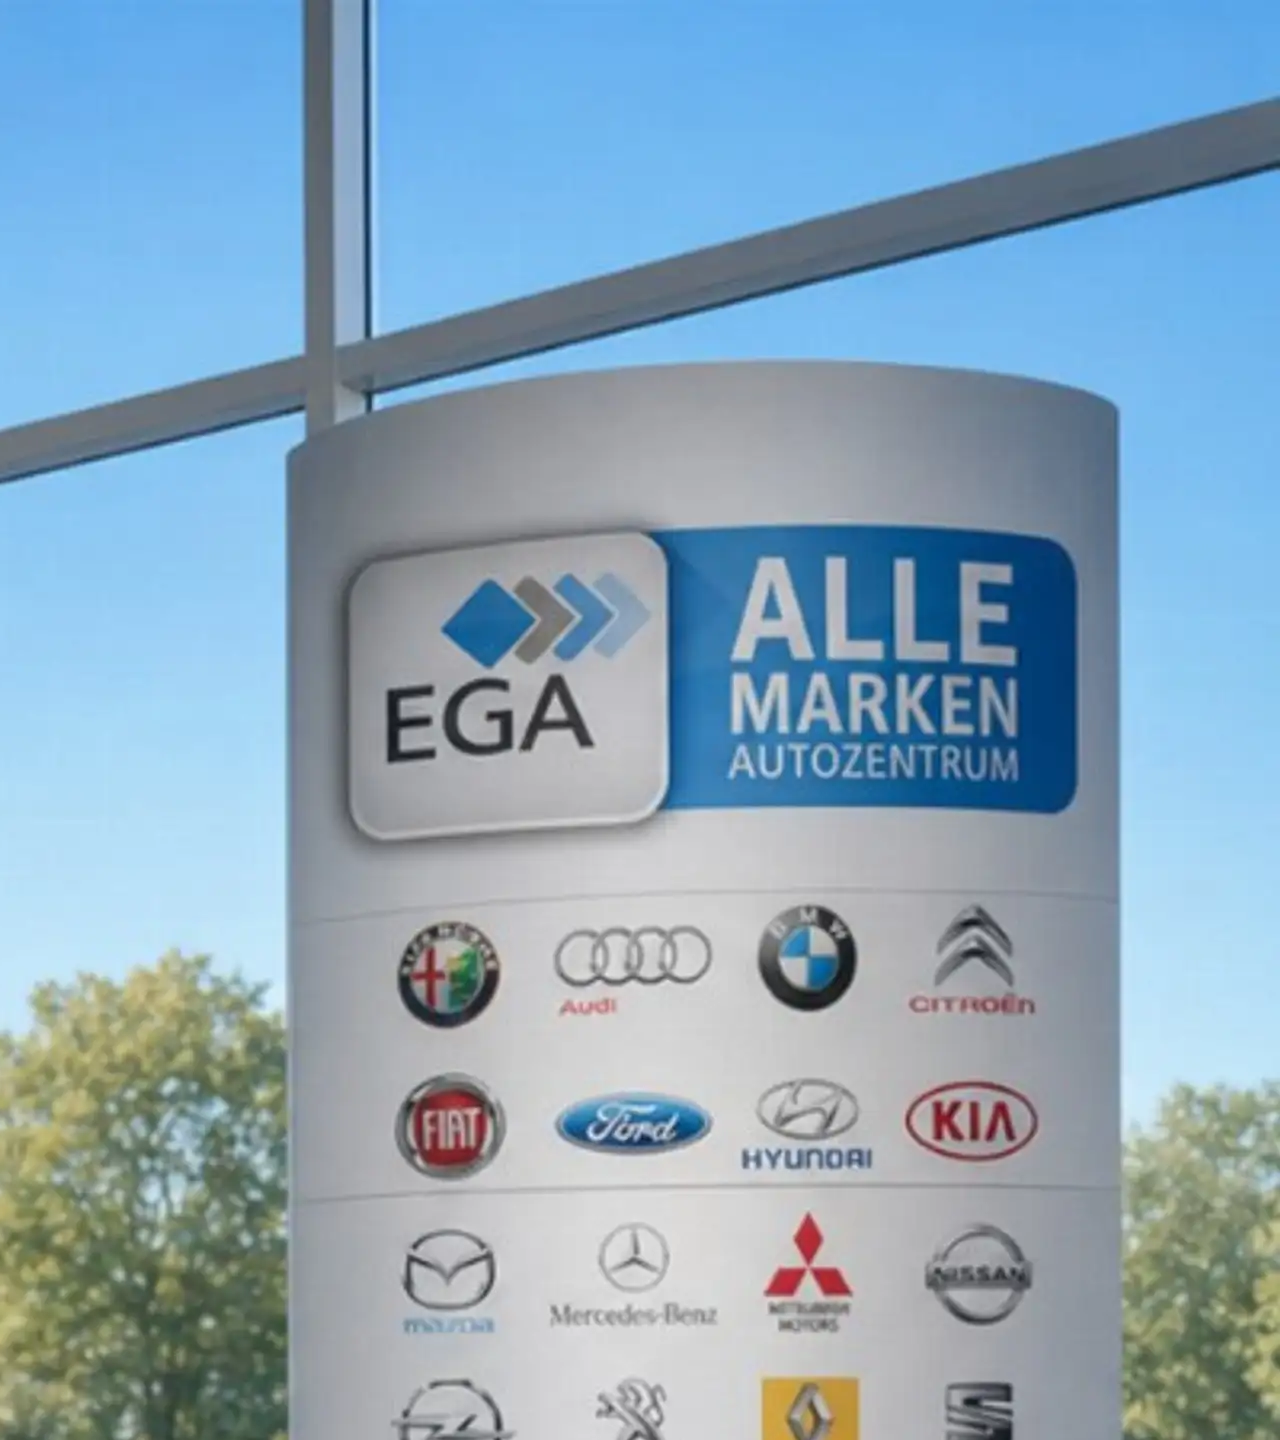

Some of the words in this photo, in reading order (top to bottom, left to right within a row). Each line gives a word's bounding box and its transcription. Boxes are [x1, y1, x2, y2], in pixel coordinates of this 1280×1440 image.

[730, 556, 1018, 668] ALLE
[386, 674, 595, 764] EGA
[730, 671, 1018, 739] MARKEN
[727, 743, 1020, 782] AUTOZENTRUM
[558, 998, 617, 1016] Audi
[421, 1106, 481, 1150] FIAT
[586, 1102, 678, 1142] Ford
[931, 1099, 1016, 1143] KIA
[741, 1147, 873, 1169] HYUNDAI
[934, 1266, 1028, 1284] NISSAN
[549, 1302, 718, 1326] Mercedes-Benz
